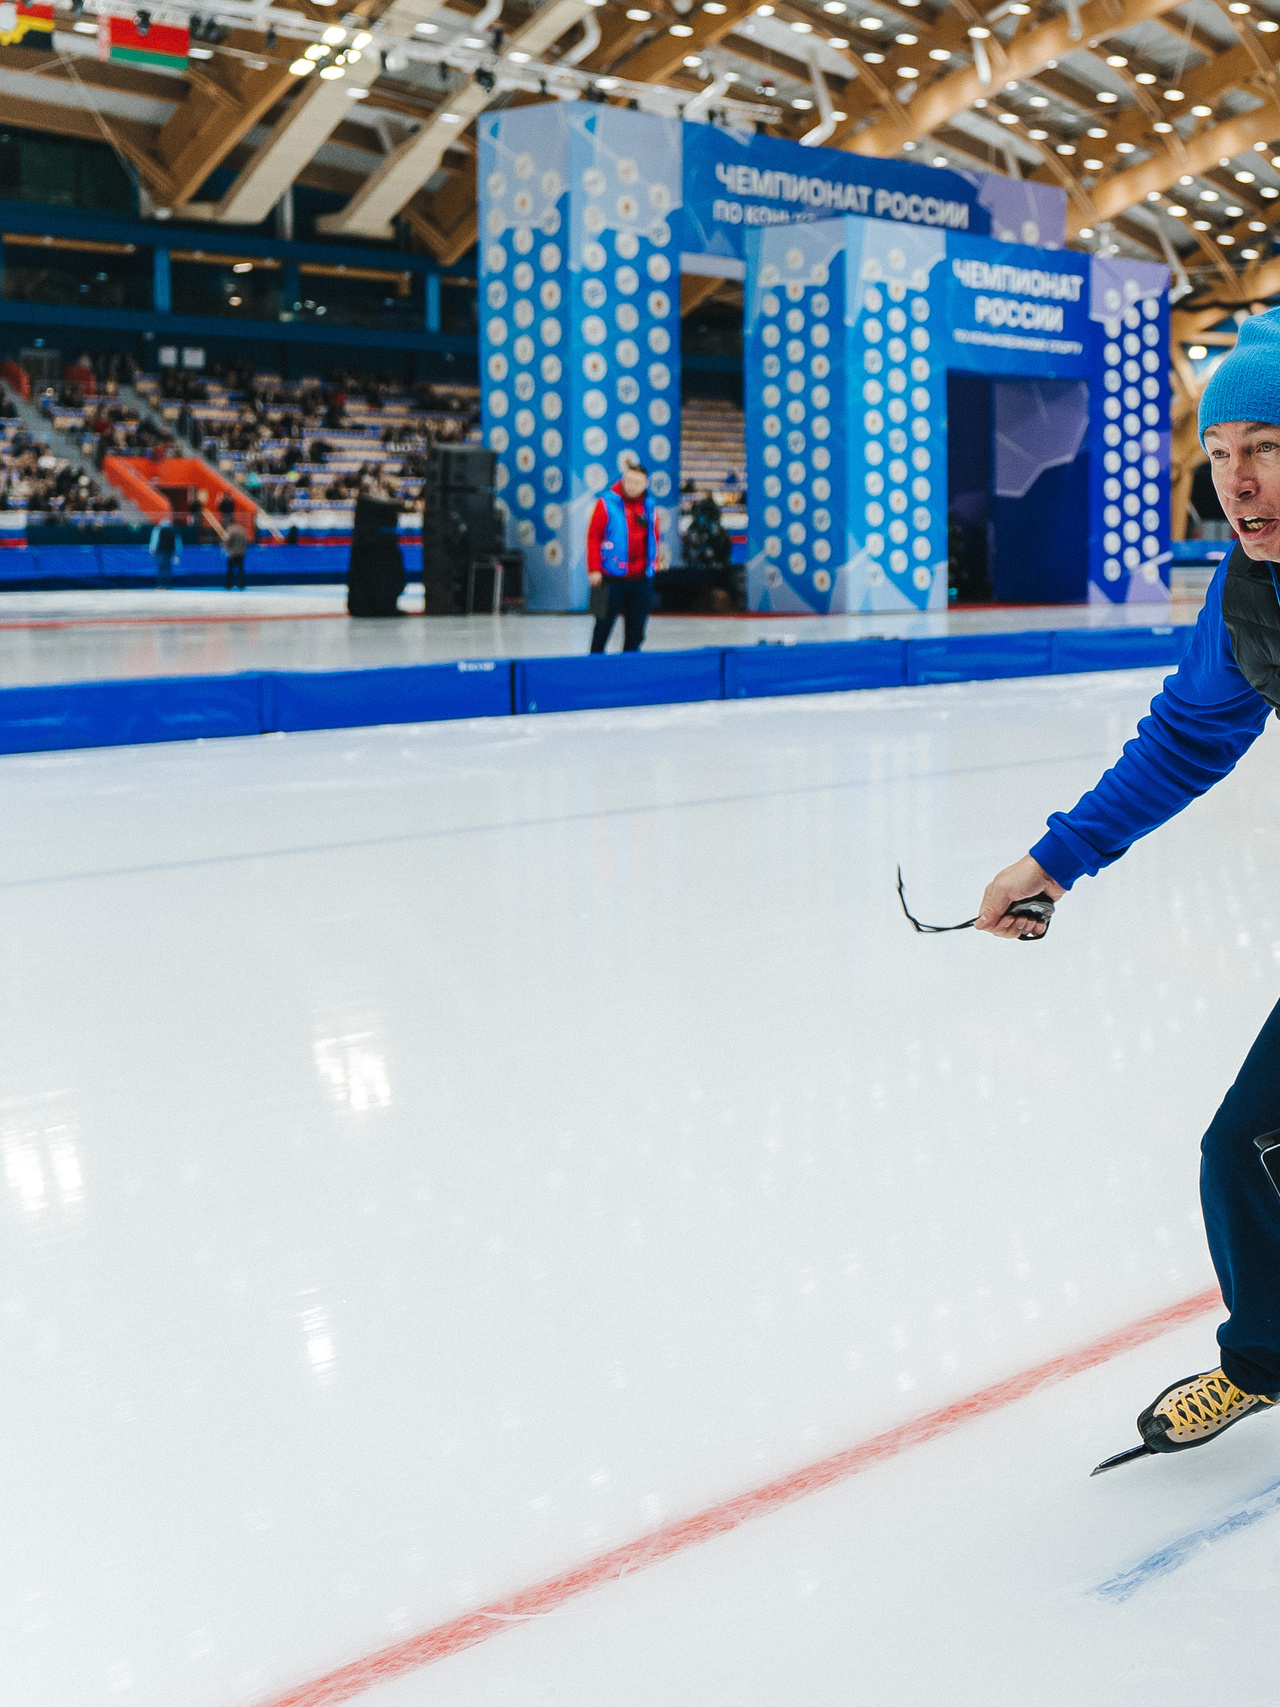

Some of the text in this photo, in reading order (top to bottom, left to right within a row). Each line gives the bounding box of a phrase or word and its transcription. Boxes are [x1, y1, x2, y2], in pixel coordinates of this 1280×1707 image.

[715, 162, 873, 214] ЧЕМПИОНАТ
[874, 188, 969, 230] РОССИИ
[952, 258, 1084, 302] ЧЕМПИОНАТ
[975, 295, 1064, 333] РОССИИ
